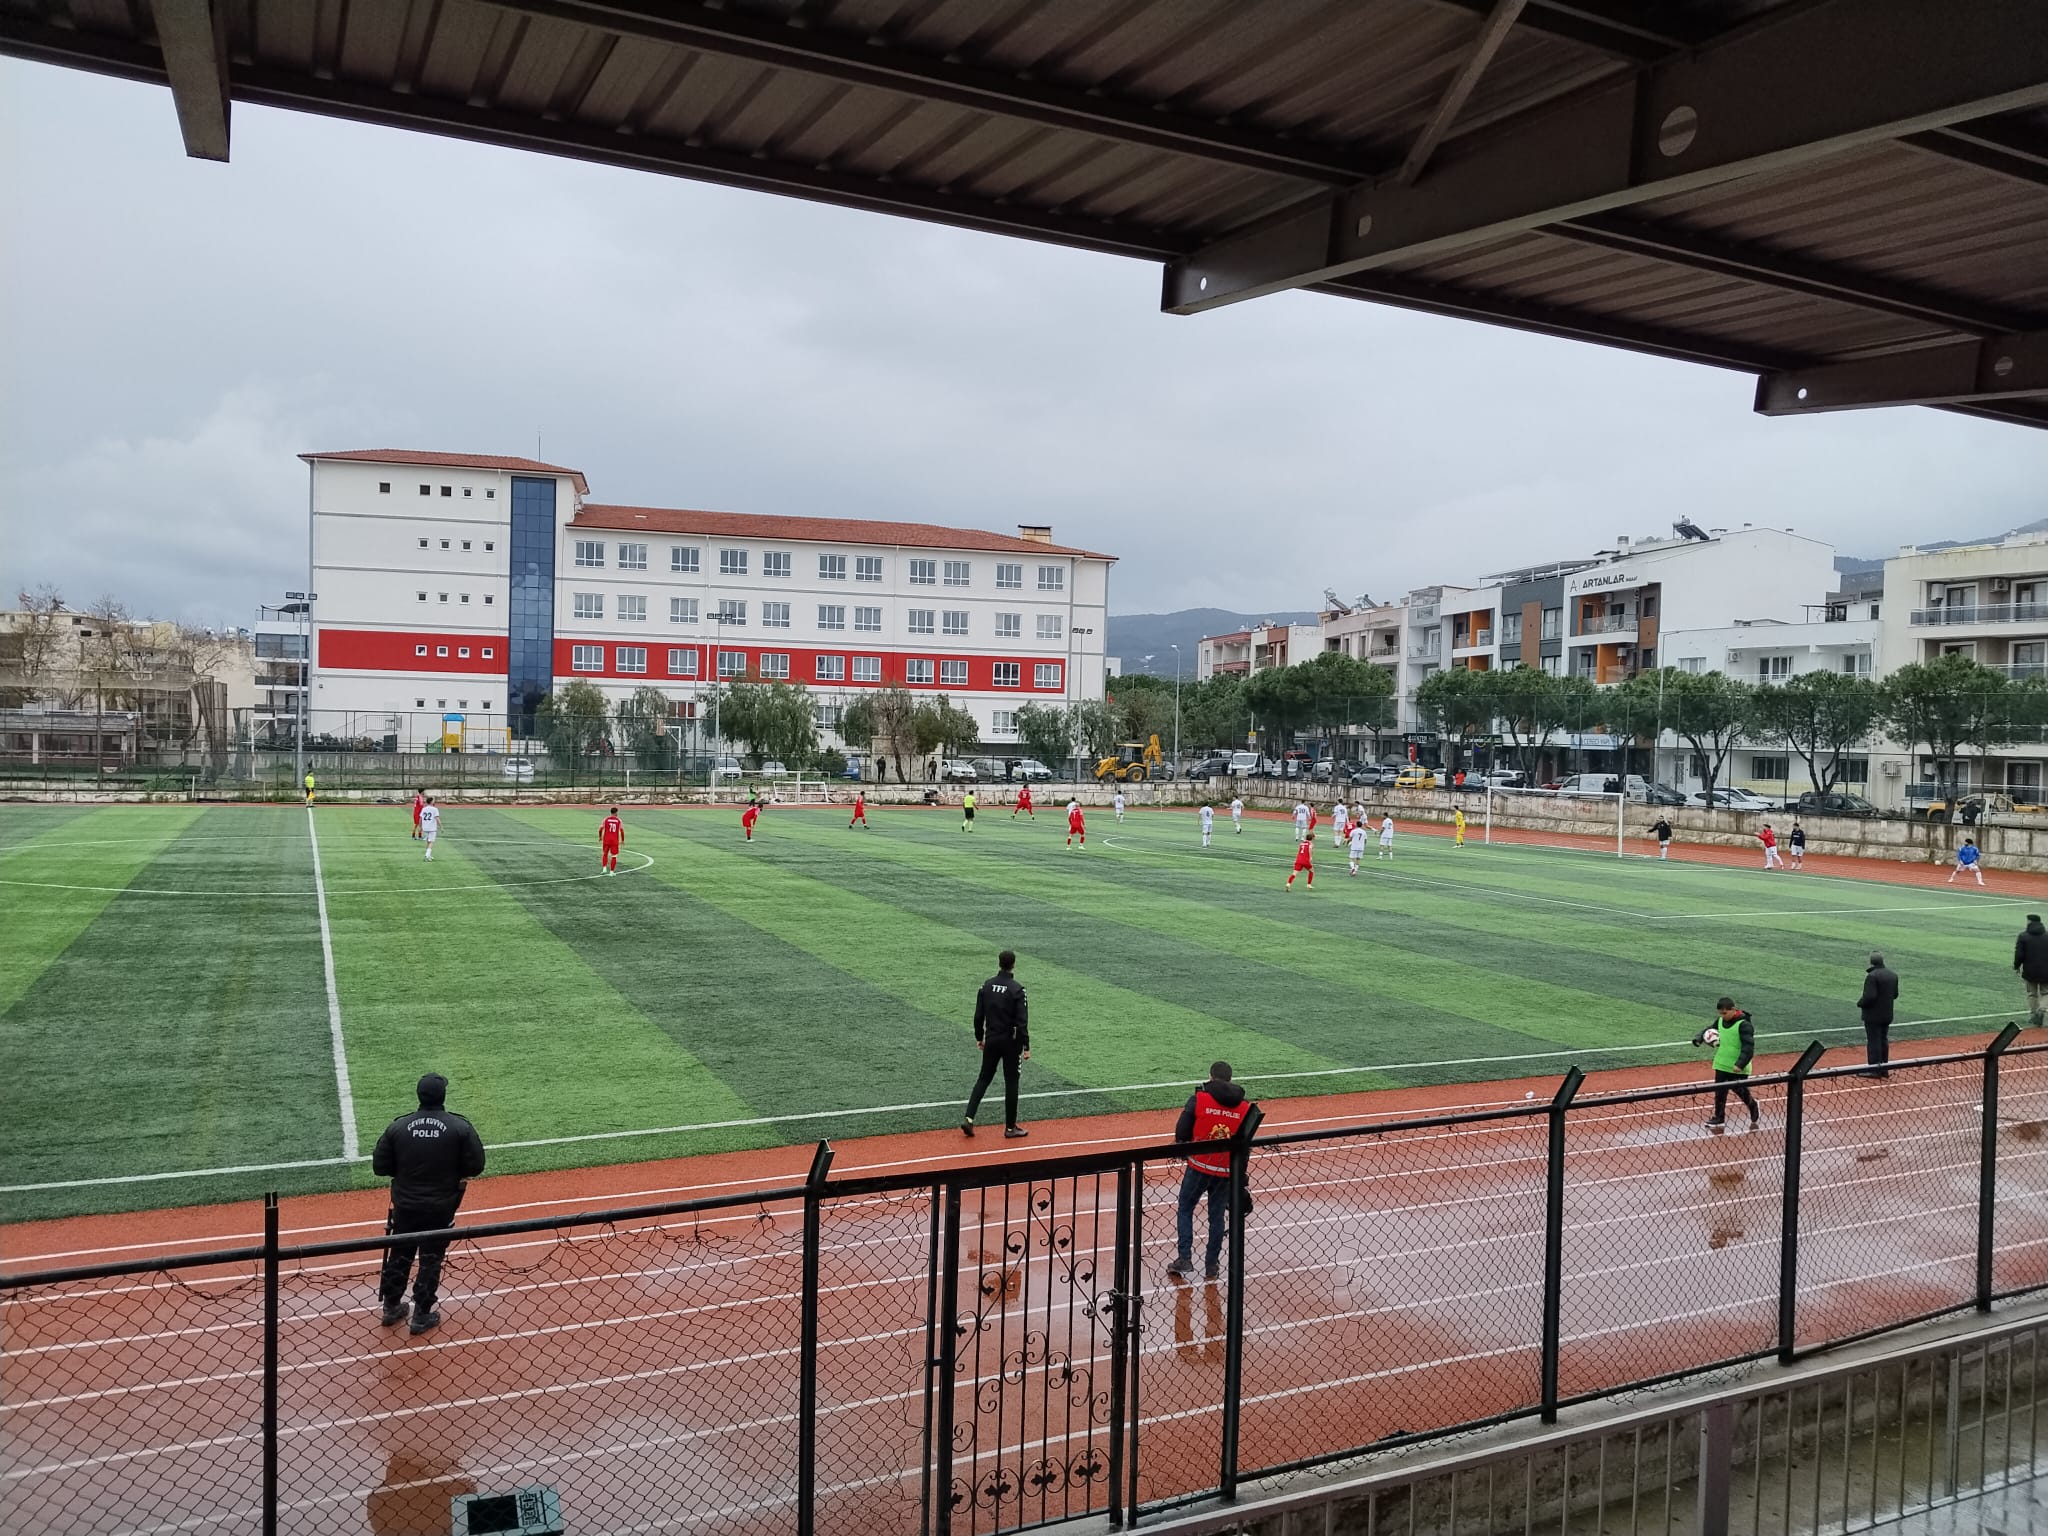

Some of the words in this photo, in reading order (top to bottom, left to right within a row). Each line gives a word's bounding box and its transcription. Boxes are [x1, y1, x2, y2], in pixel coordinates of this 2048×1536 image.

[1582, 574, 1625, 589] ARTANLAR
[423, 812, 432, 821] 22
[609, 822, 617, 833] 70
[1358, 833, 1363, 841] 7
[992, 984, 1008, 993] TFF
[1205, 1107, 1221, 1116] SPOR
